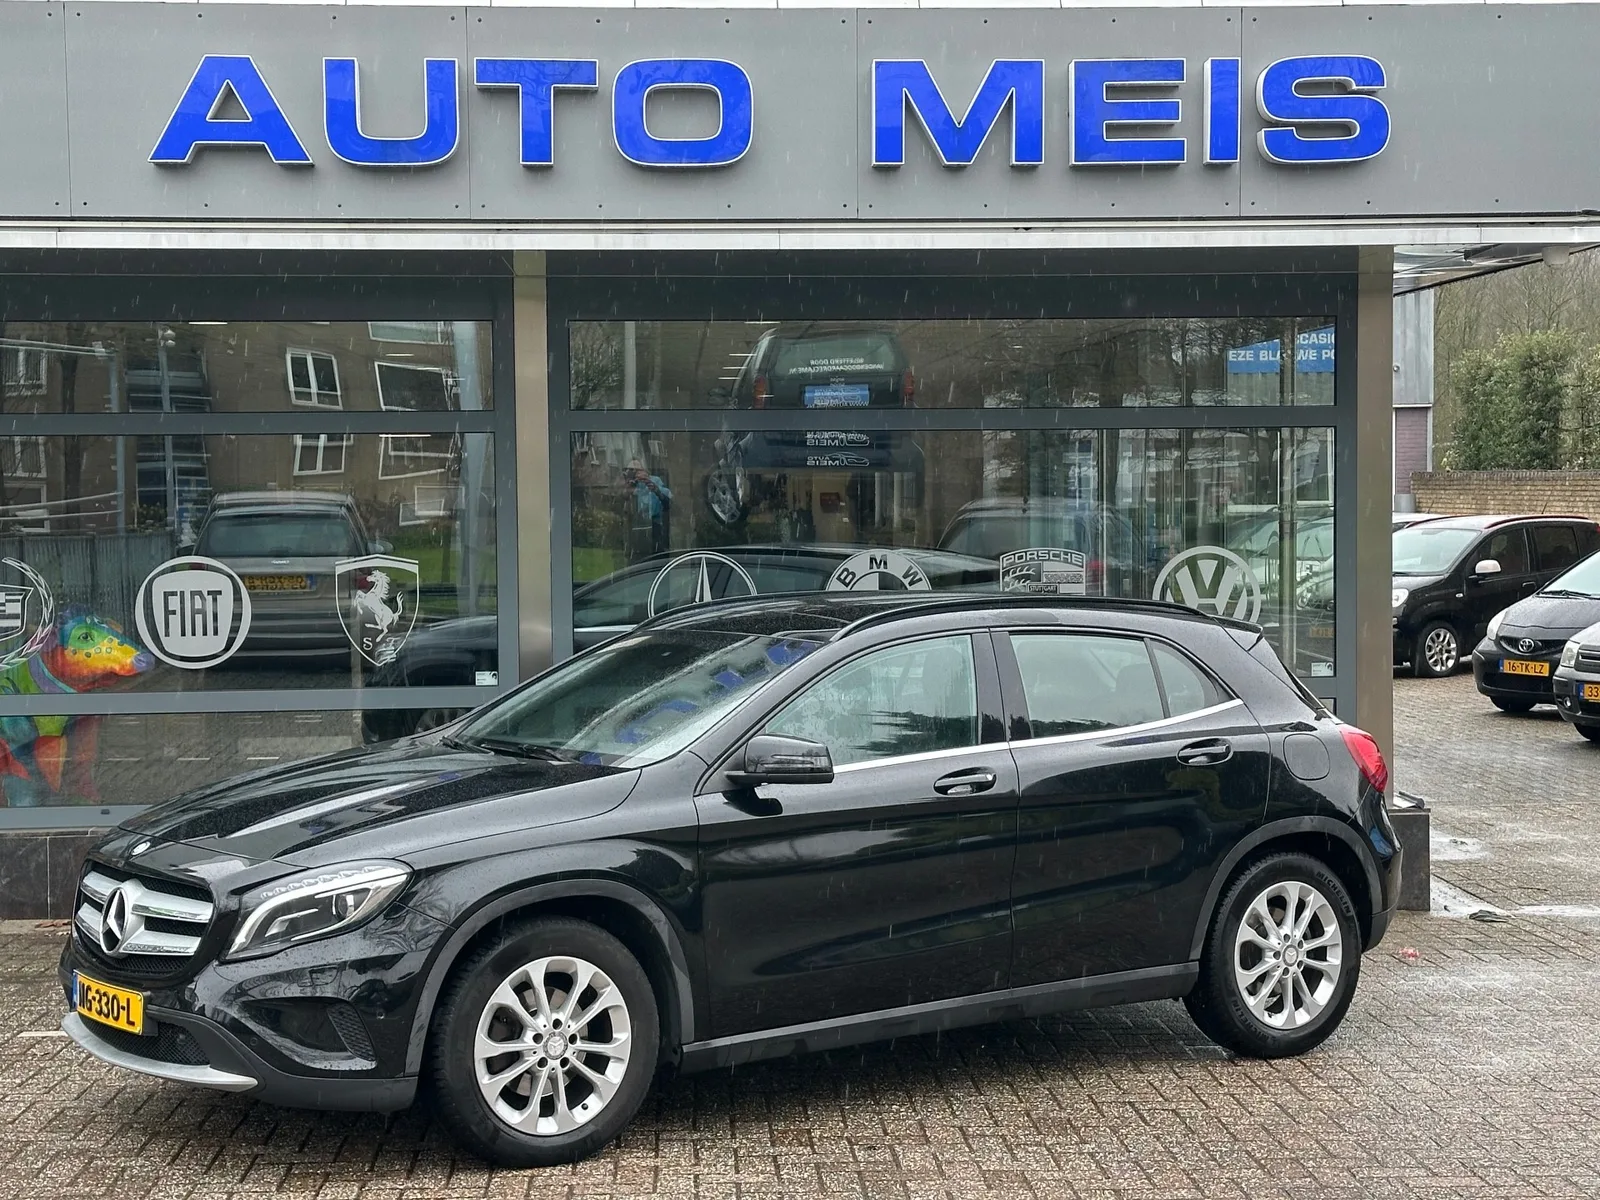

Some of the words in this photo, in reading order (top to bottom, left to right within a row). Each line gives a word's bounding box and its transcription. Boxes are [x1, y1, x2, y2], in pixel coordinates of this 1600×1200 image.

[148, 54, 754, 167] AUTO
[870, 54, 1391, 167] MEIS
[1297, 333, 1335, 345] CASI
[1003, 550, 1083, 568] PORSCHE
[163, 590, 222, 638] FIAT
[1507, 661, 1545, 675] 16-TK-LZ
[1315, 870, 1352, 914] MICHELIN
